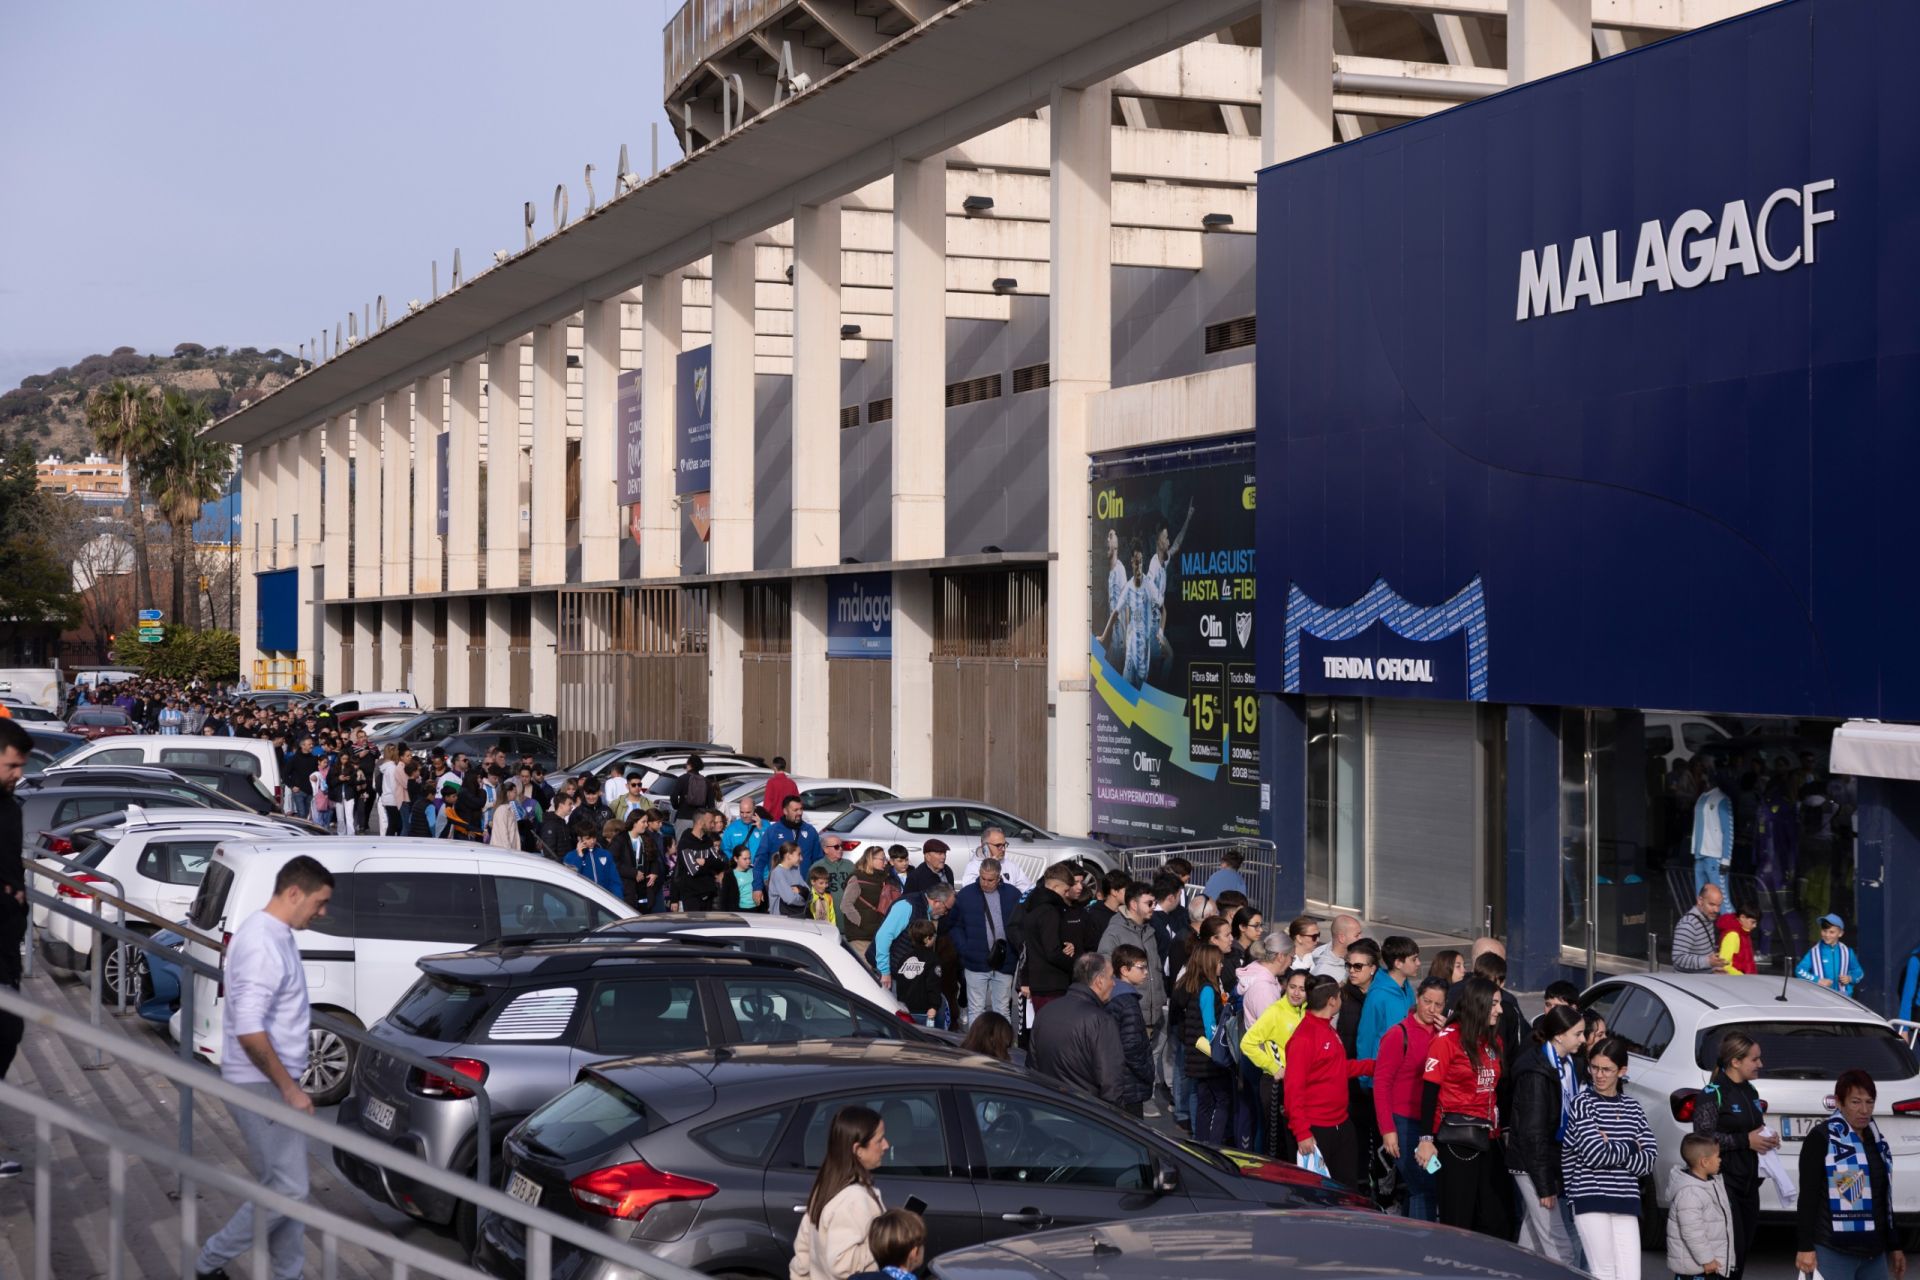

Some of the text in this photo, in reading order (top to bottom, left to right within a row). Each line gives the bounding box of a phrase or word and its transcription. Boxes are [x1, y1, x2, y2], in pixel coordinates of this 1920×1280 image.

[1097, 487, 1124, 520] Olin
[1181, 550, 1256, 576] MALAGUIST
[1182, 580, 1220, 601] HASTA
[1233, 578, 1256, 600] FIB
[838, 582, 891, 632] málaga
[1200, 614, 1222, 638] Olin
[1206, 672, 1219, 683] Start
[1323, 656, 1374, 680] TIENDA
[1376, 657, 1433, 682] OFICIAL
[1232, 747, 1252, 760] 300Mb
[1232, 766, 1248, 779] 20GB
[1097, 787, 1119, 800] LALIGA
[1119, 789, 1165, 806] HYPERMOTION
